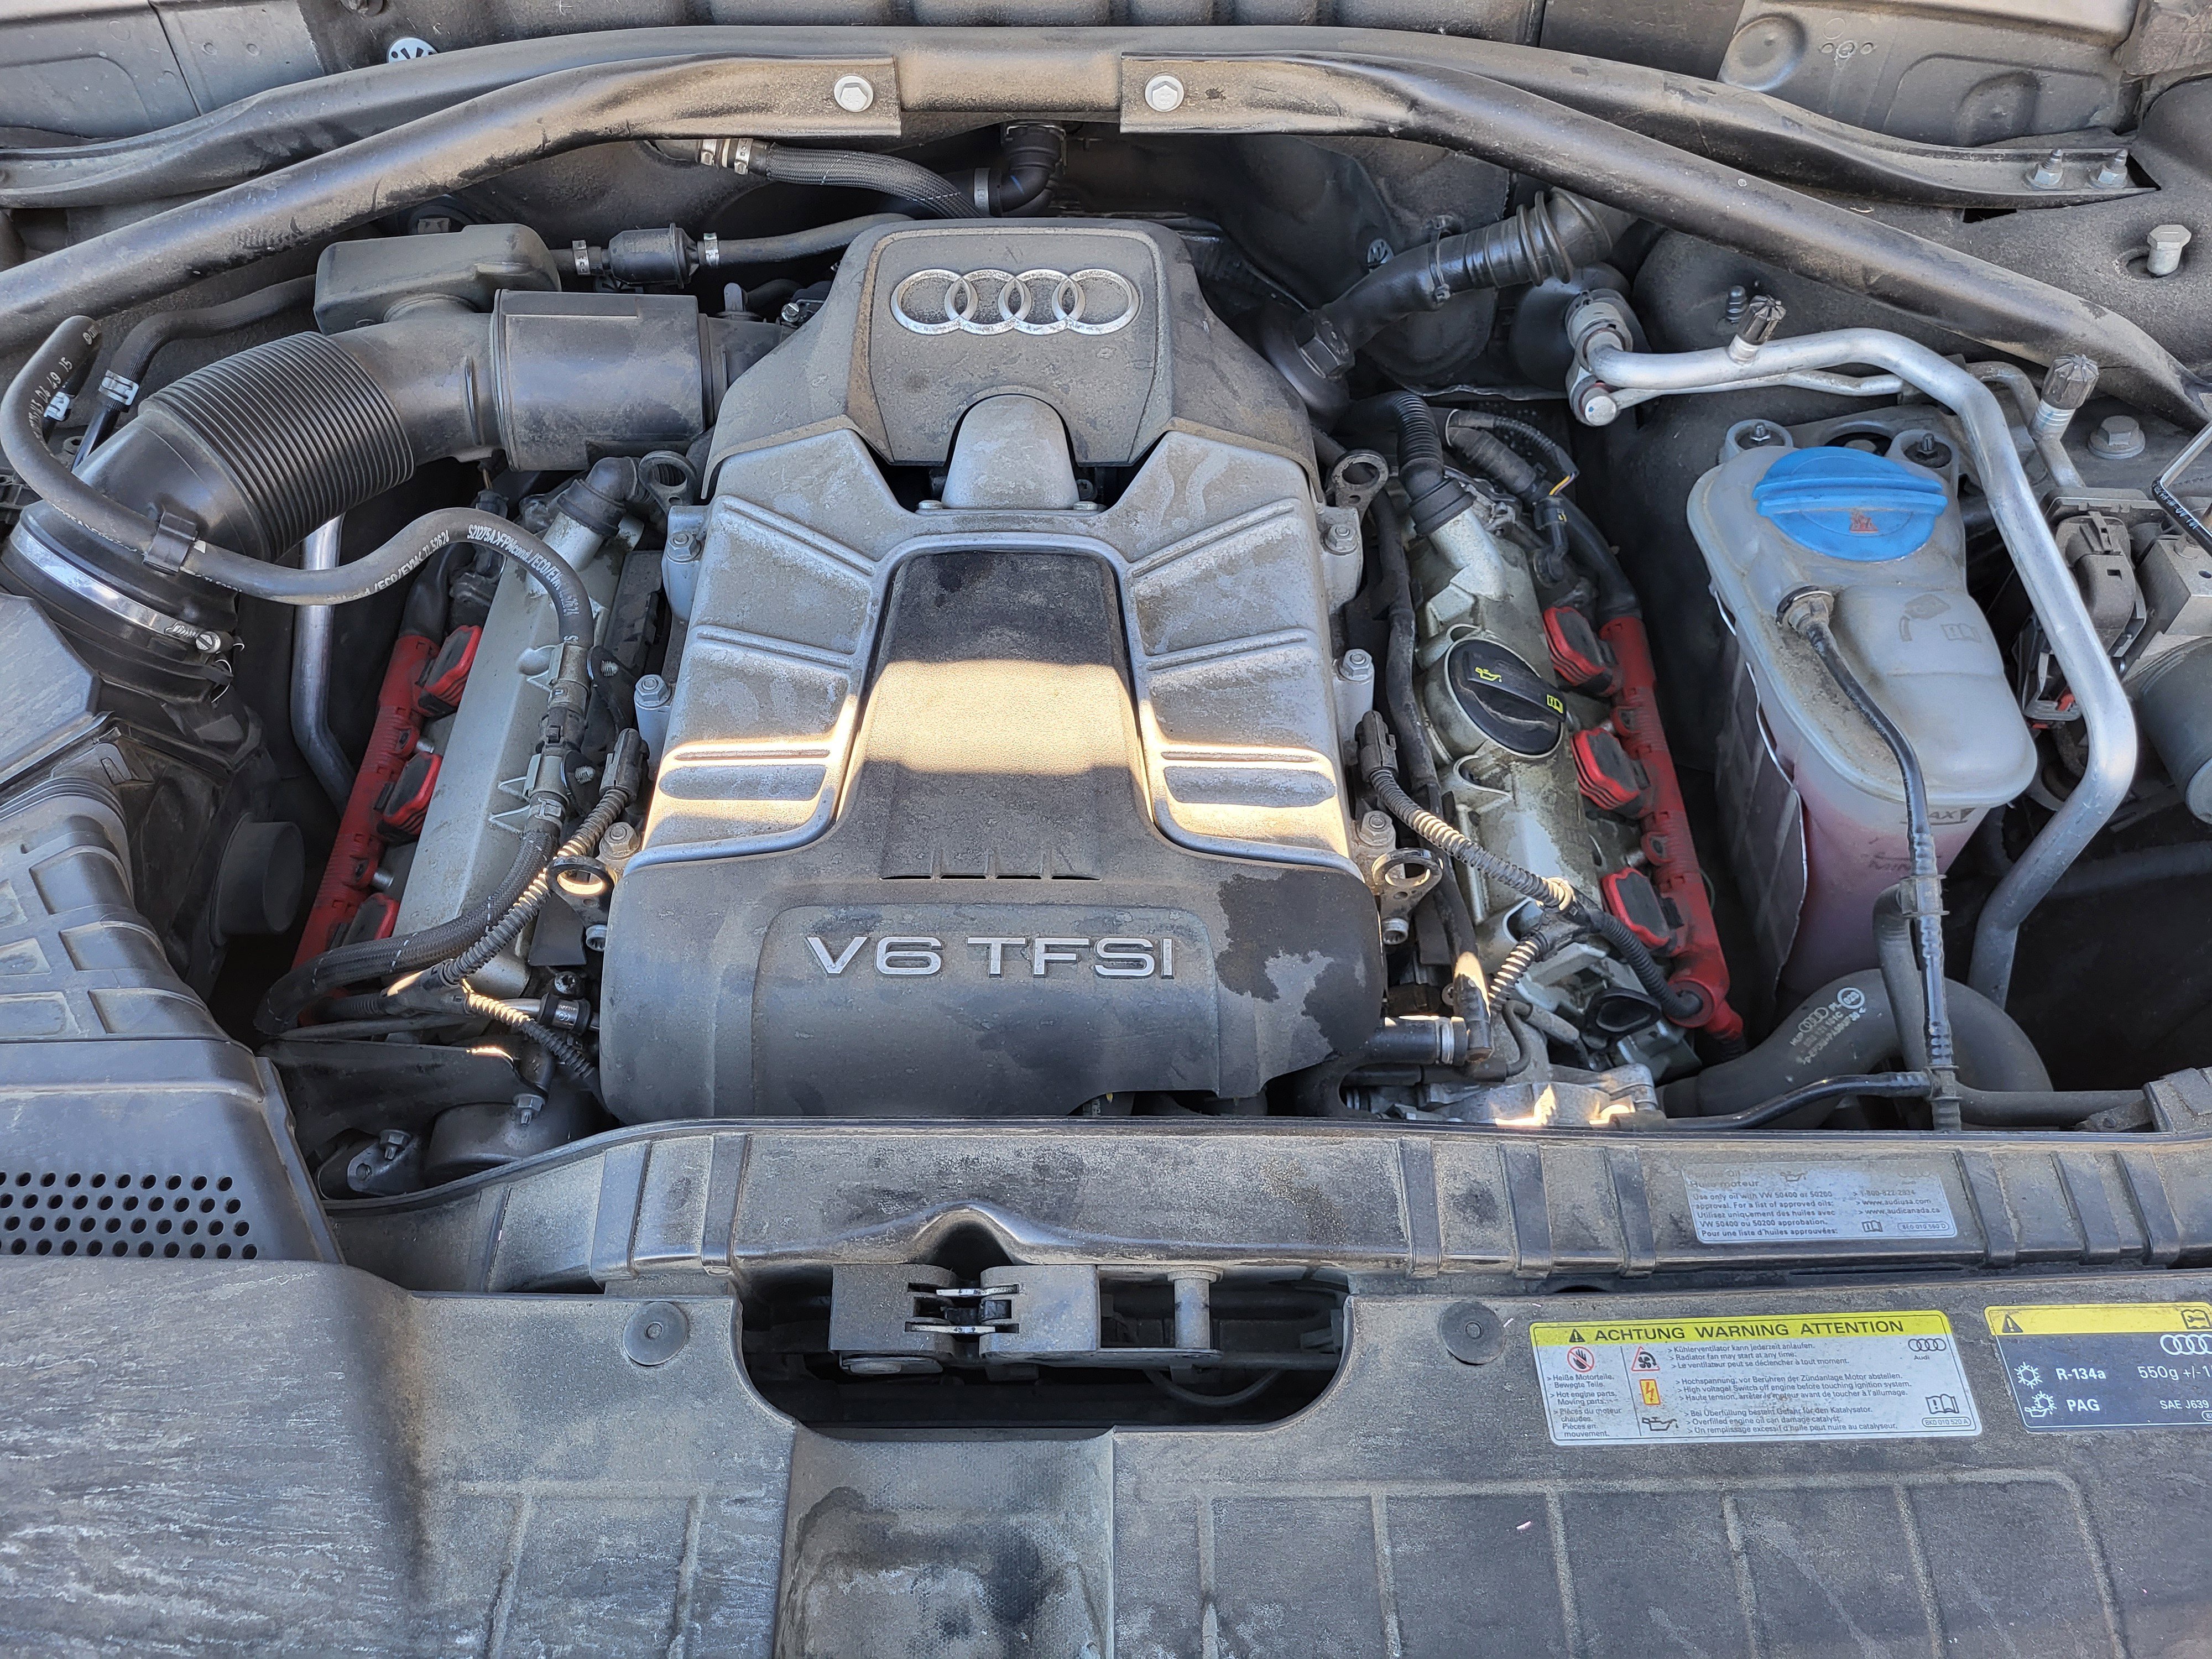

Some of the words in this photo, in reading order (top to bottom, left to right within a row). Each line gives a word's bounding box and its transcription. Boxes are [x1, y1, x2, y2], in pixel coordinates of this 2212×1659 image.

[47, 372, 61, 389] 49
[59, 357, 73, 372] 15
[806, 936, 943, 976] V6
[967, 936, 1174, 979] TFSI
[1780, 1199, 1815, 1209] approved
[1728, 1210, 1773, 1219] uniquement
[1778, 1218, 1828, 1227] approbation.
[1595, 1327, 1686, 1342] ACHTUNG
[1694, 1323, 1790, 1338] WARNING
[1800, 1320, 1904, 1335] ATTENTION
[1755, 1359, 1793, 1367] déclencher
[2055, 1368, 2106, 1380] R-134a
[2137, 1365, 2179, 1380] 550g
[2066, 1399, 2101, 1412] PAG
[2159, 1400, 2183, 1410] SAE
[2185, 1400, 2209, 1409] J639
[1704, 1408, 1747, 1417] Überfüllung
[1777, 1407, 1801, 1415] Gefahr
[1707, 1425, 1751, 1434] remplissage
[1859, 1422, 1897, 1431] catalyseur.
